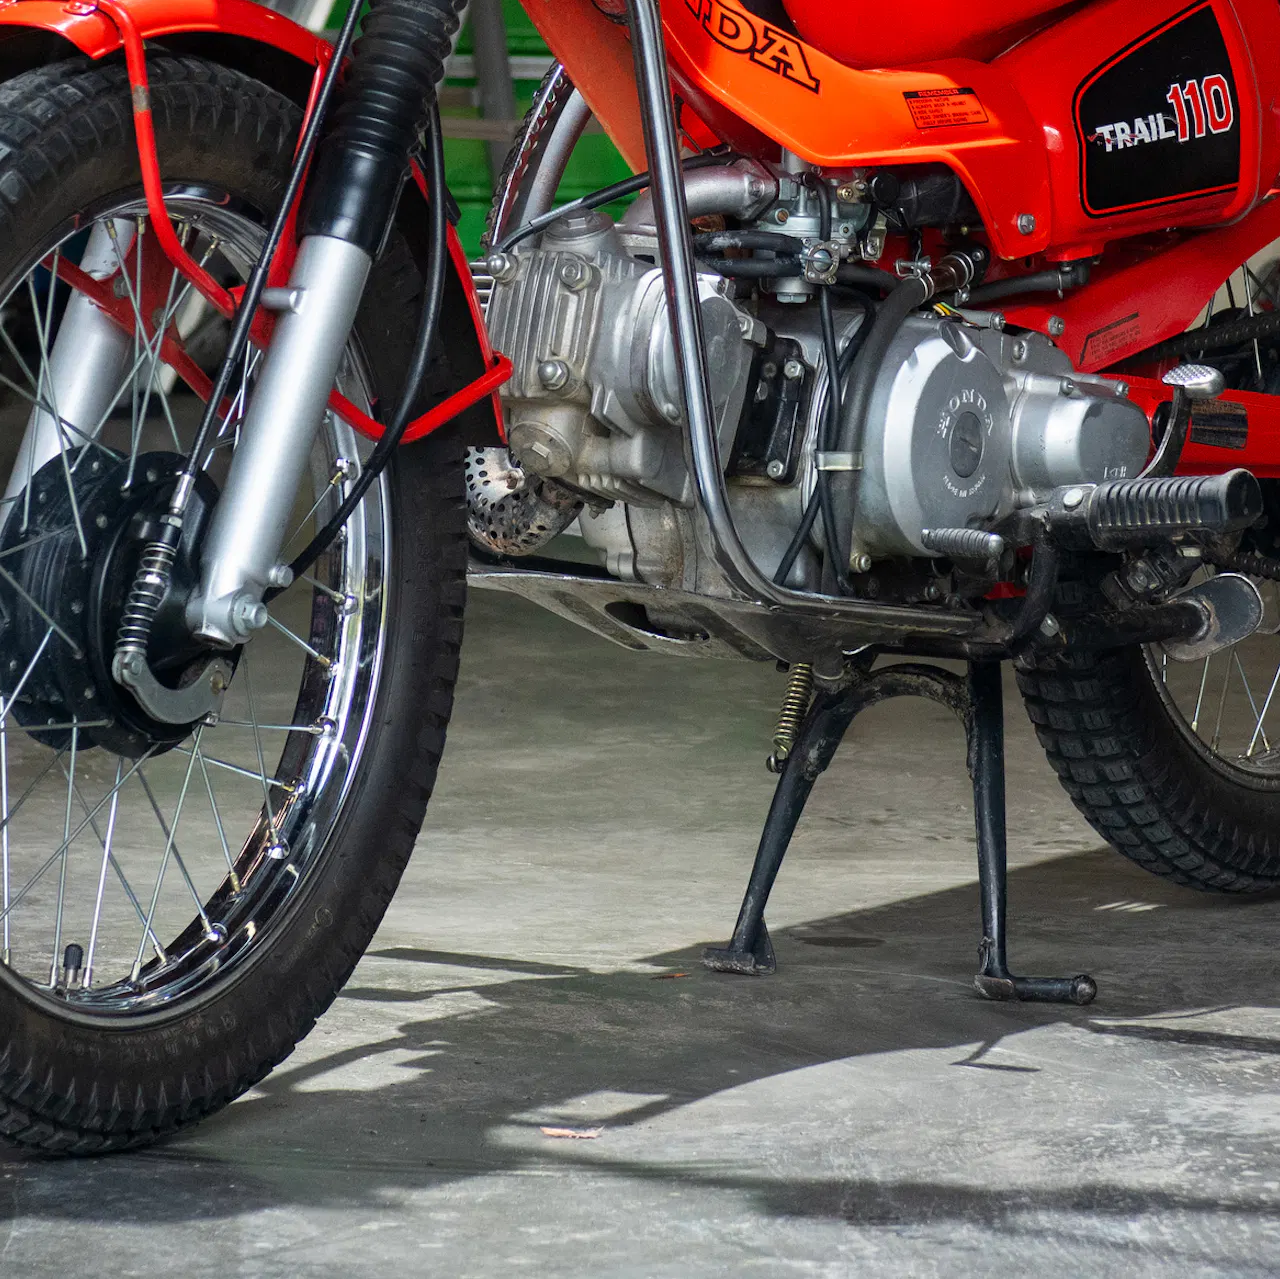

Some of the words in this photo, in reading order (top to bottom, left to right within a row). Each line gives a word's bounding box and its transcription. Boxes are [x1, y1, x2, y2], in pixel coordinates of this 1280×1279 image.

[1094, 113, 1177, 153] TRAIL
[1166, 73, 1234, 143] 110
[936, 388, 994, 439] HONDA
